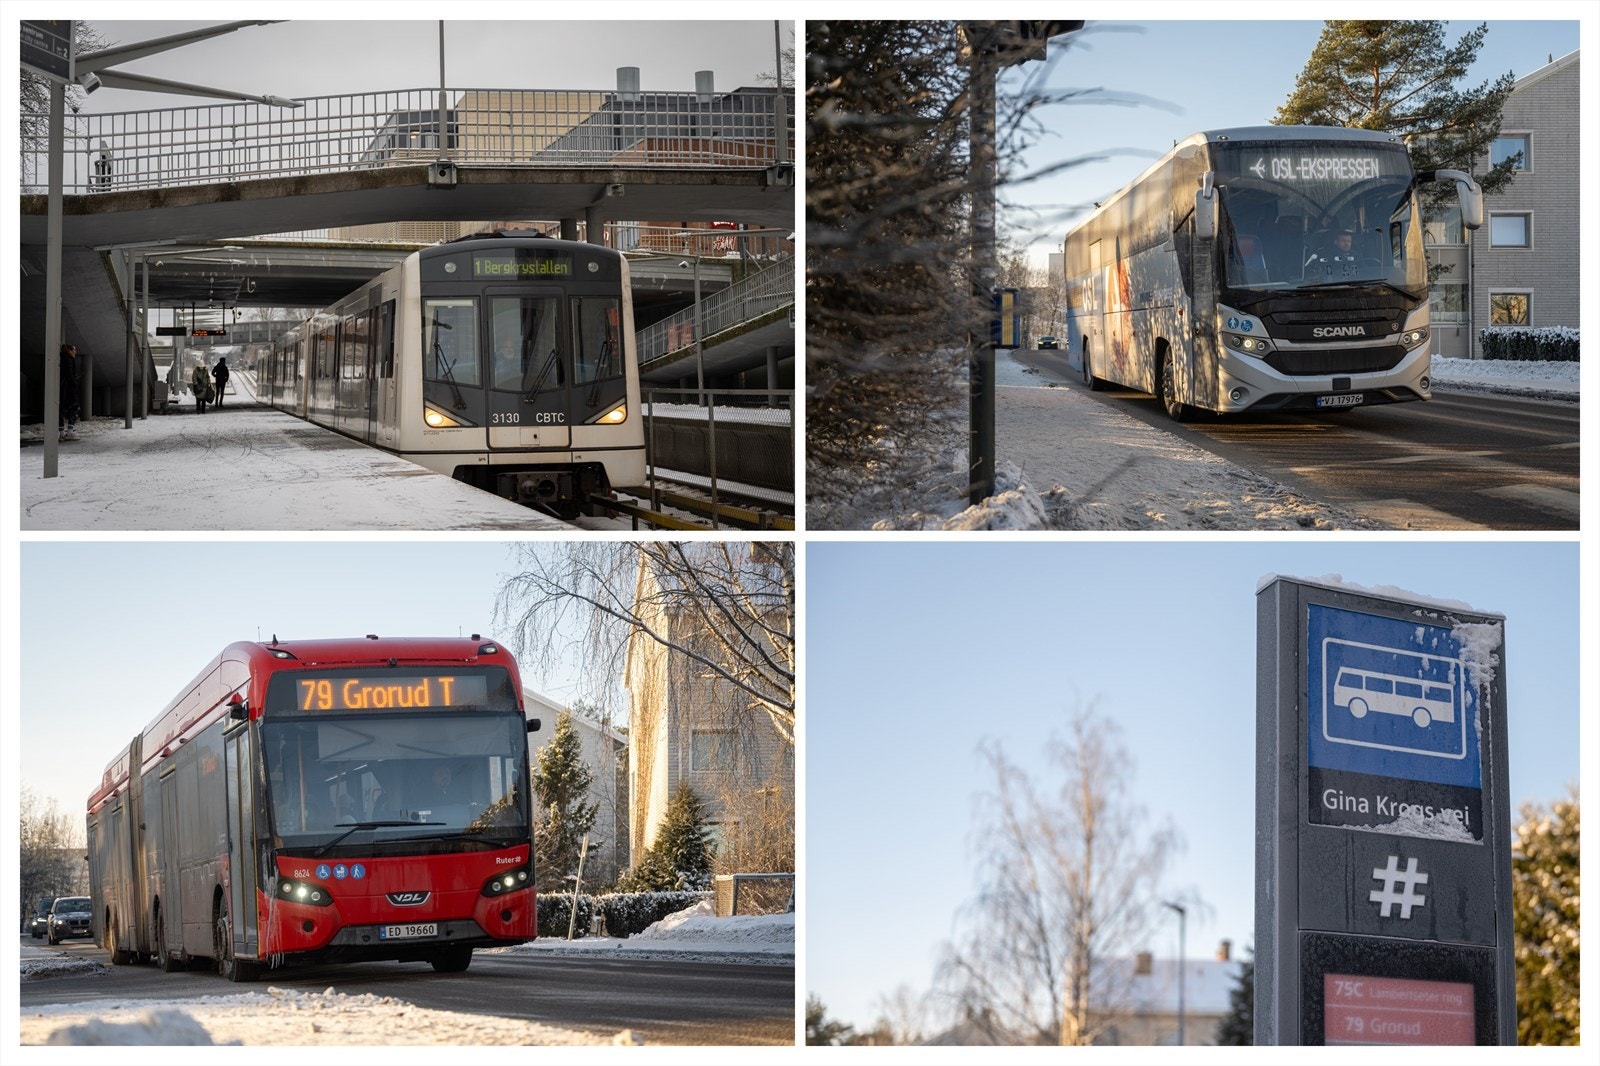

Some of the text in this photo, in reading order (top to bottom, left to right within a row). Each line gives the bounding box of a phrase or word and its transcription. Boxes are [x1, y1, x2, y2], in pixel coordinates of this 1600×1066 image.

[63, 48, 68, 58] 2
[1271, 157, 1380, 180] OSL-EKSPRESSEN
[475, 260, 568, 275] 1 Bergkrystallen
[1082, 276, 1099, 312] OSL
[1312, 325, 1366, 338] SCANIA
[1324, 396, 1359, 405] VJ 17976
[492, 412, 565, 424] 3130 CBTC
[301, 677, 455, 710] 79 Grorud T
[1322, 788, 1369, 814] Gina
[294, 869, 310, 878] 8624
[393, 894, 423, 902] VDL
[388, 925, 435, 937] ED 19660
[1334, 980, 1363, 997] 75C
[1443, 992, 1463, 1005] ring
[1344, 1016, 1422, 1036] 79 Grorud
